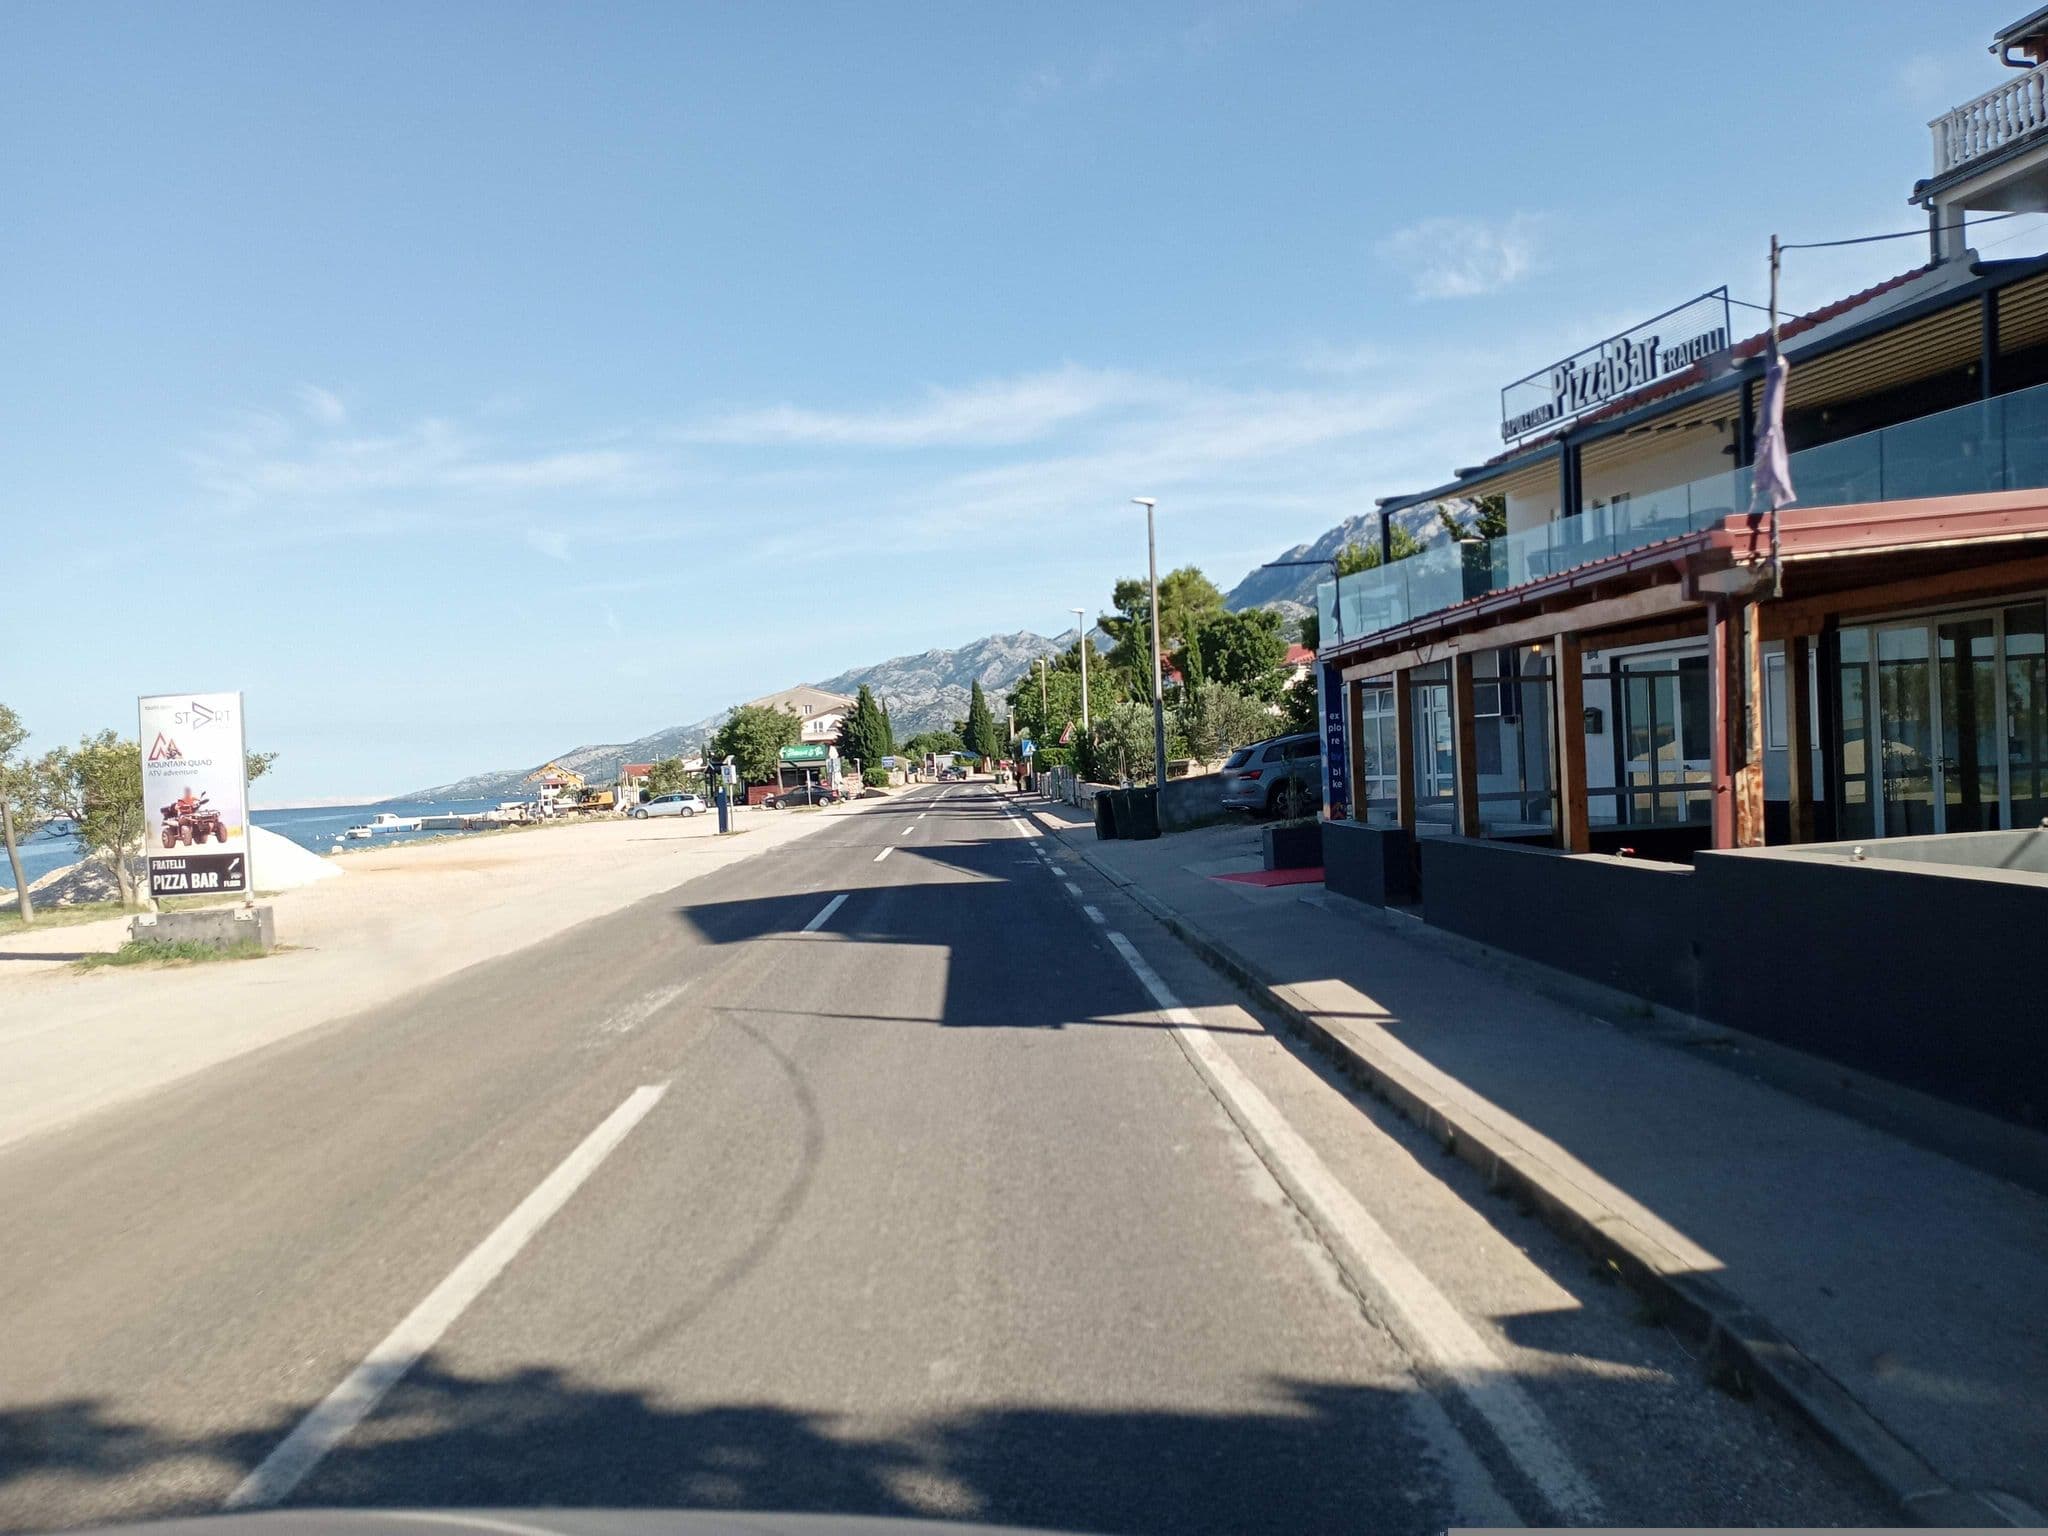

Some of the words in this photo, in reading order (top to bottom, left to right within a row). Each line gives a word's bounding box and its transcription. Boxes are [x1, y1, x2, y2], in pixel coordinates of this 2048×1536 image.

[1551, 336, 1659, 417] PizzaBar
[1661, 327, 1724, 374] FRATELLI
[1328, 723, 1342, 733] plo
[1331, 737, 1340, 745] re
[148, 760, 186, 768] MOUNTAIN
[188, 759, 212, 767] QUAD
[163, 769, 198, 777] adventure
[152, 859, 186, 870] FRATELLI
[153, 873, 188, 890] PIZZA
[191, 872, 218, 888] BAR
